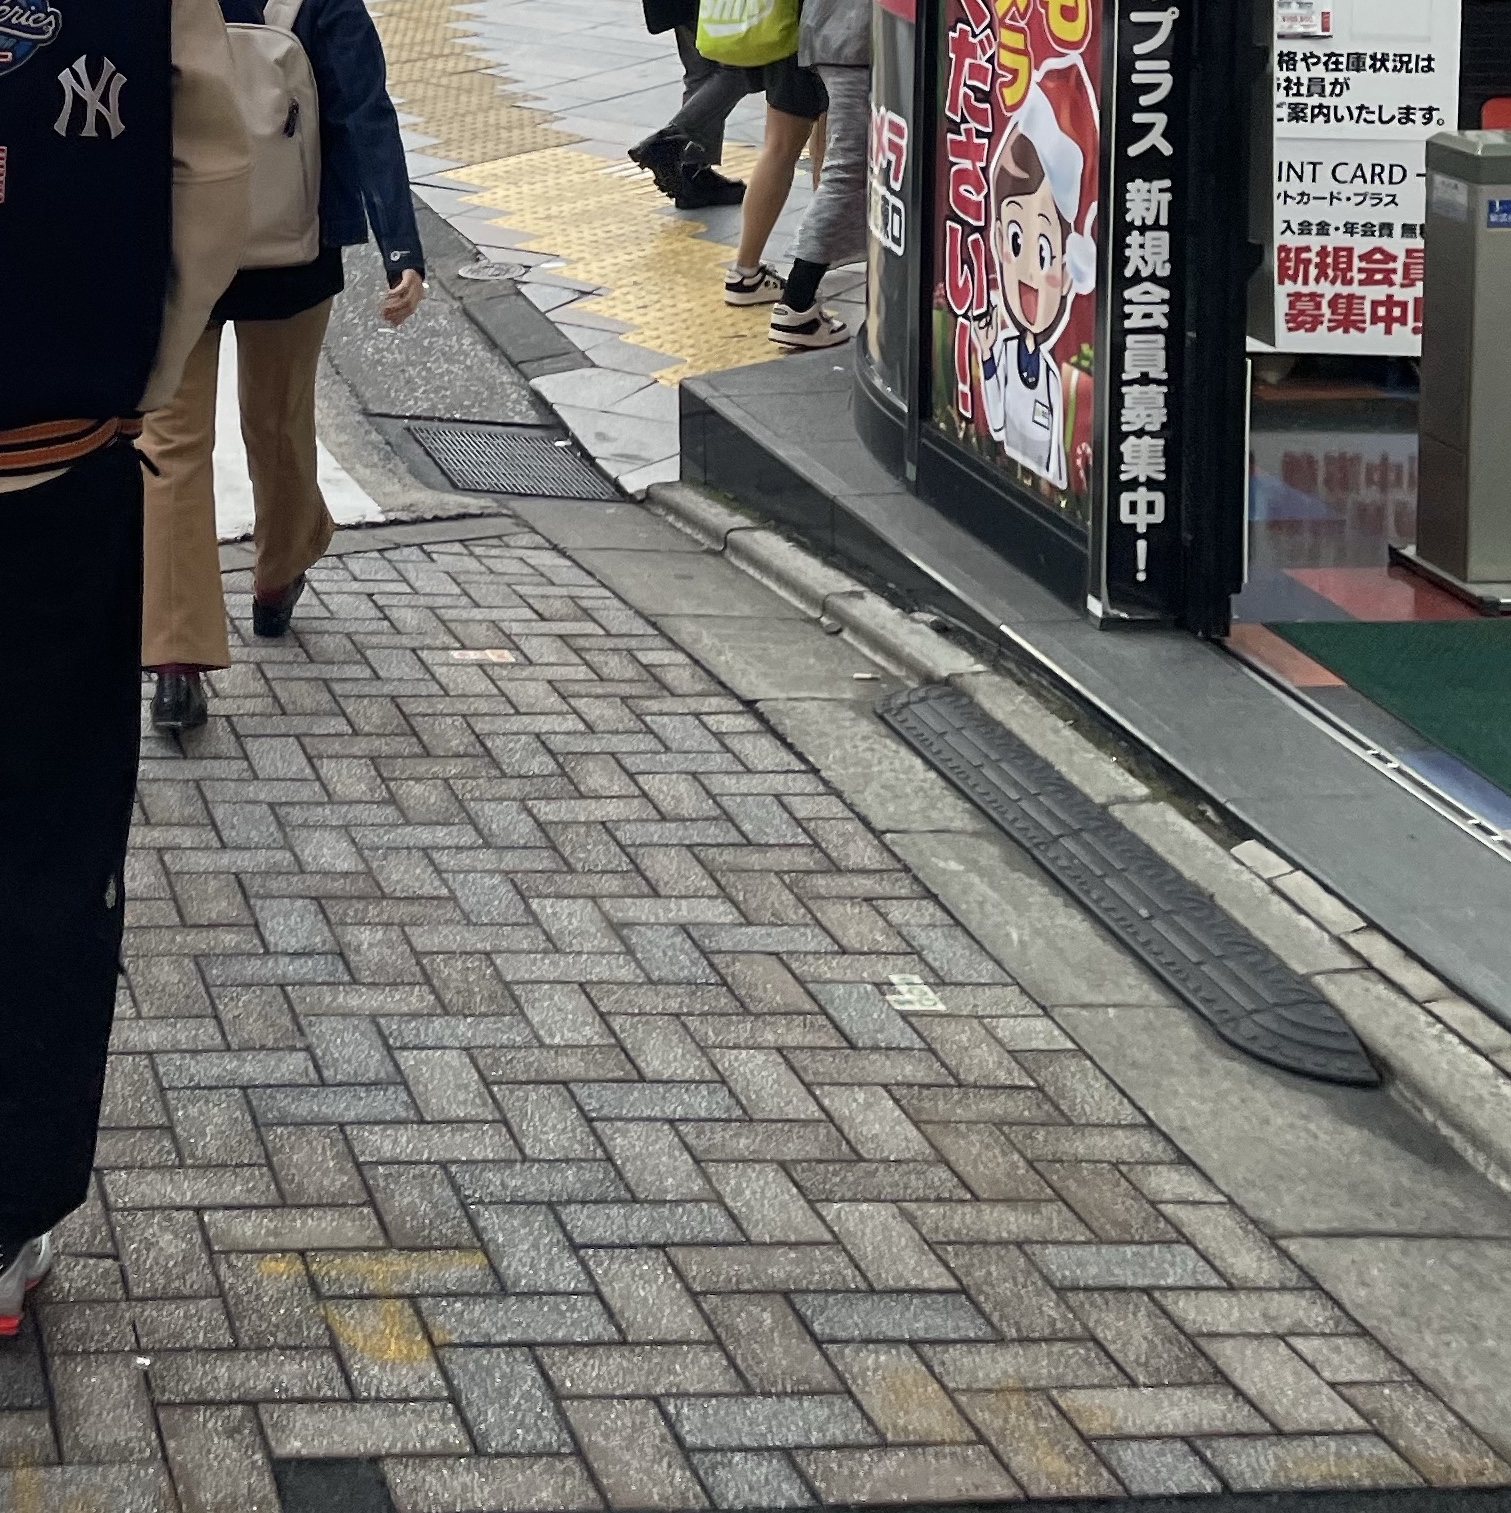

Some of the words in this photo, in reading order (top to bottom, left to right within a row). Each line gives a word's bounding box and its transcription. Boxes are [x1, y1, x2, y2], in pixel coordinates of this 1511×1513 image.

[53, 53, 128, 140] NY
[1331, 162, 1408, 186] CARD
[1280, 219, 1395, 239] 入会金・年会費
[1276, 243, 1425, 289] 新規会員
[1119, 179, 1173, 583] 新規会員募集中!
